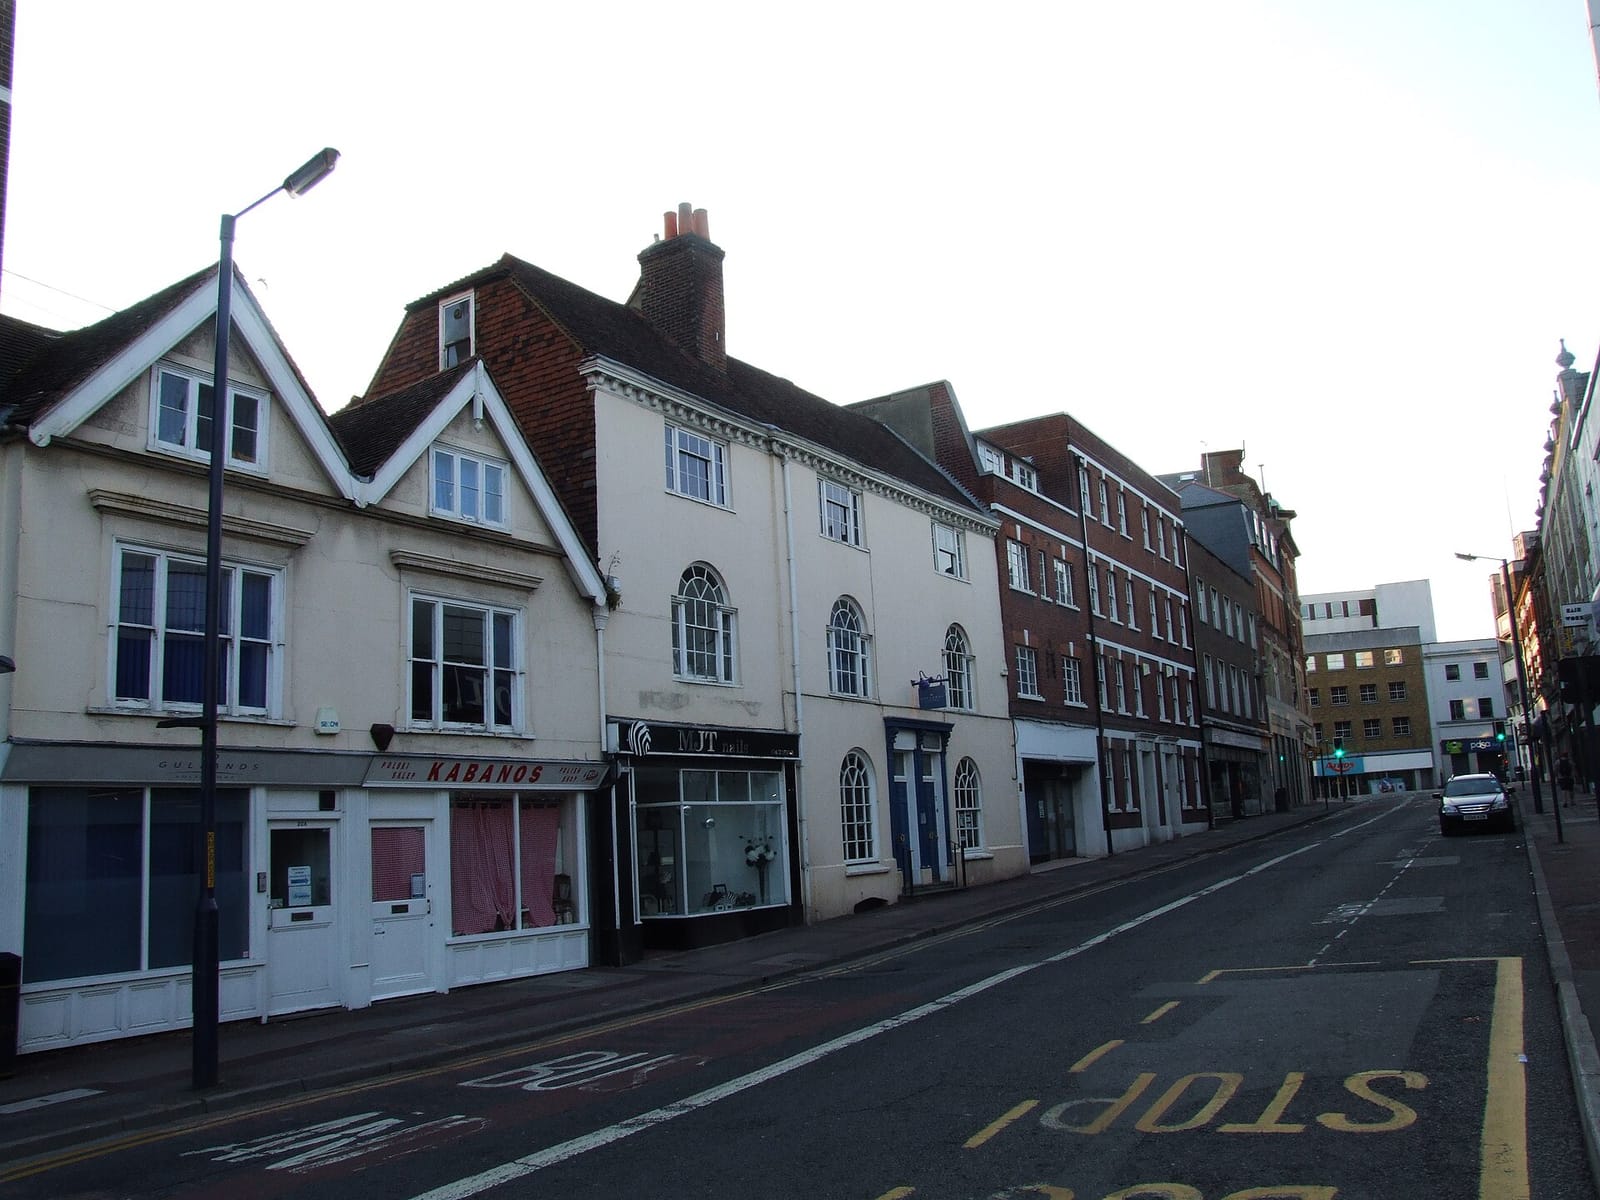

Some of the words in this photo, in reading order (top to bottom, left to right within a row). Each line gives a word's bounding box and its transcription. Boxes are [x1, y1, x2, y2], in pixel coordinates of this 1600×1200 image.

[677, 728, 718, 752] MJT
[158, 761, 260, 770] GULNDS
[427, 761, 544, 783] KABANOS
[1039, 1069, 1430, 1135] STOP
